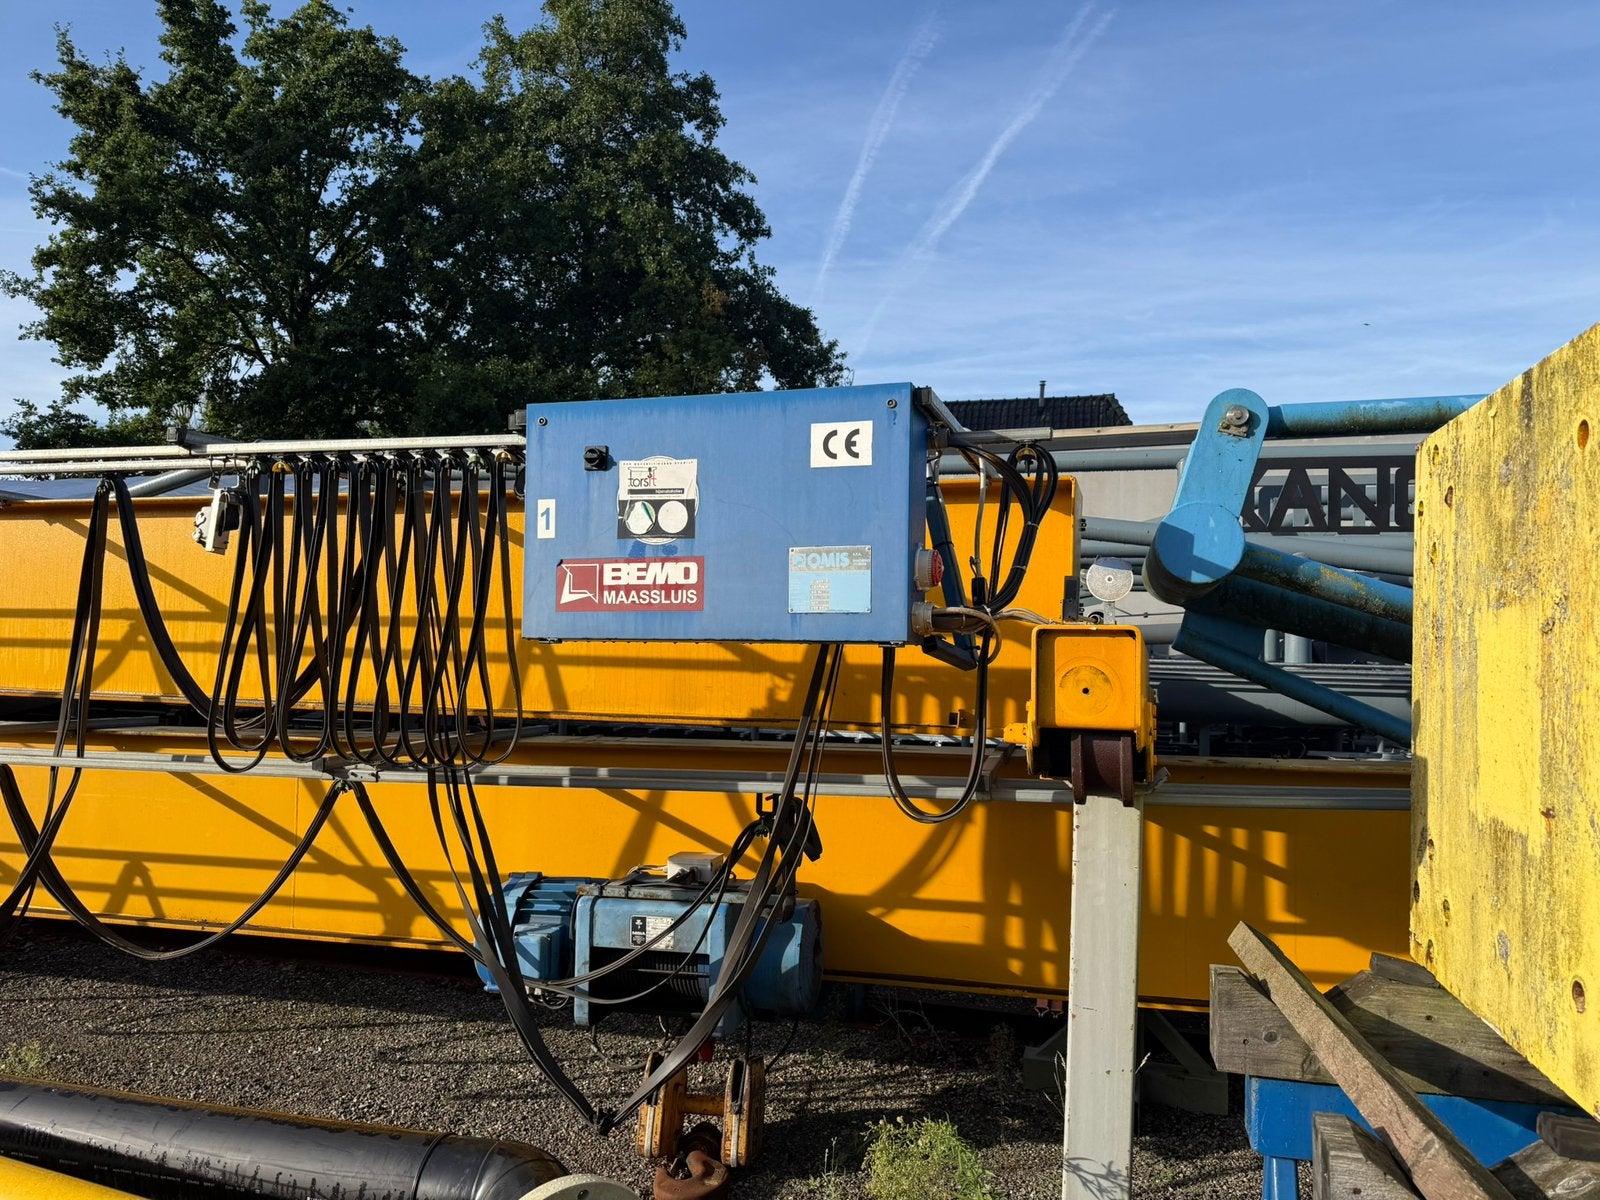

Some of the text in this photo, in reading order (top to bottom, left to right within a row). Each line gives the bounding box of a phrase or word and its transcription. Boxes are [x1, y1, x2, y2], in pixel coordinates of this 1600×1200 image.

[822, 428, 860, 460] CE
[540, 507, 551, 531] 1
[603, 562, 698, 586] BEMO
[603, 590, 698, 604] MAASSLUIS
